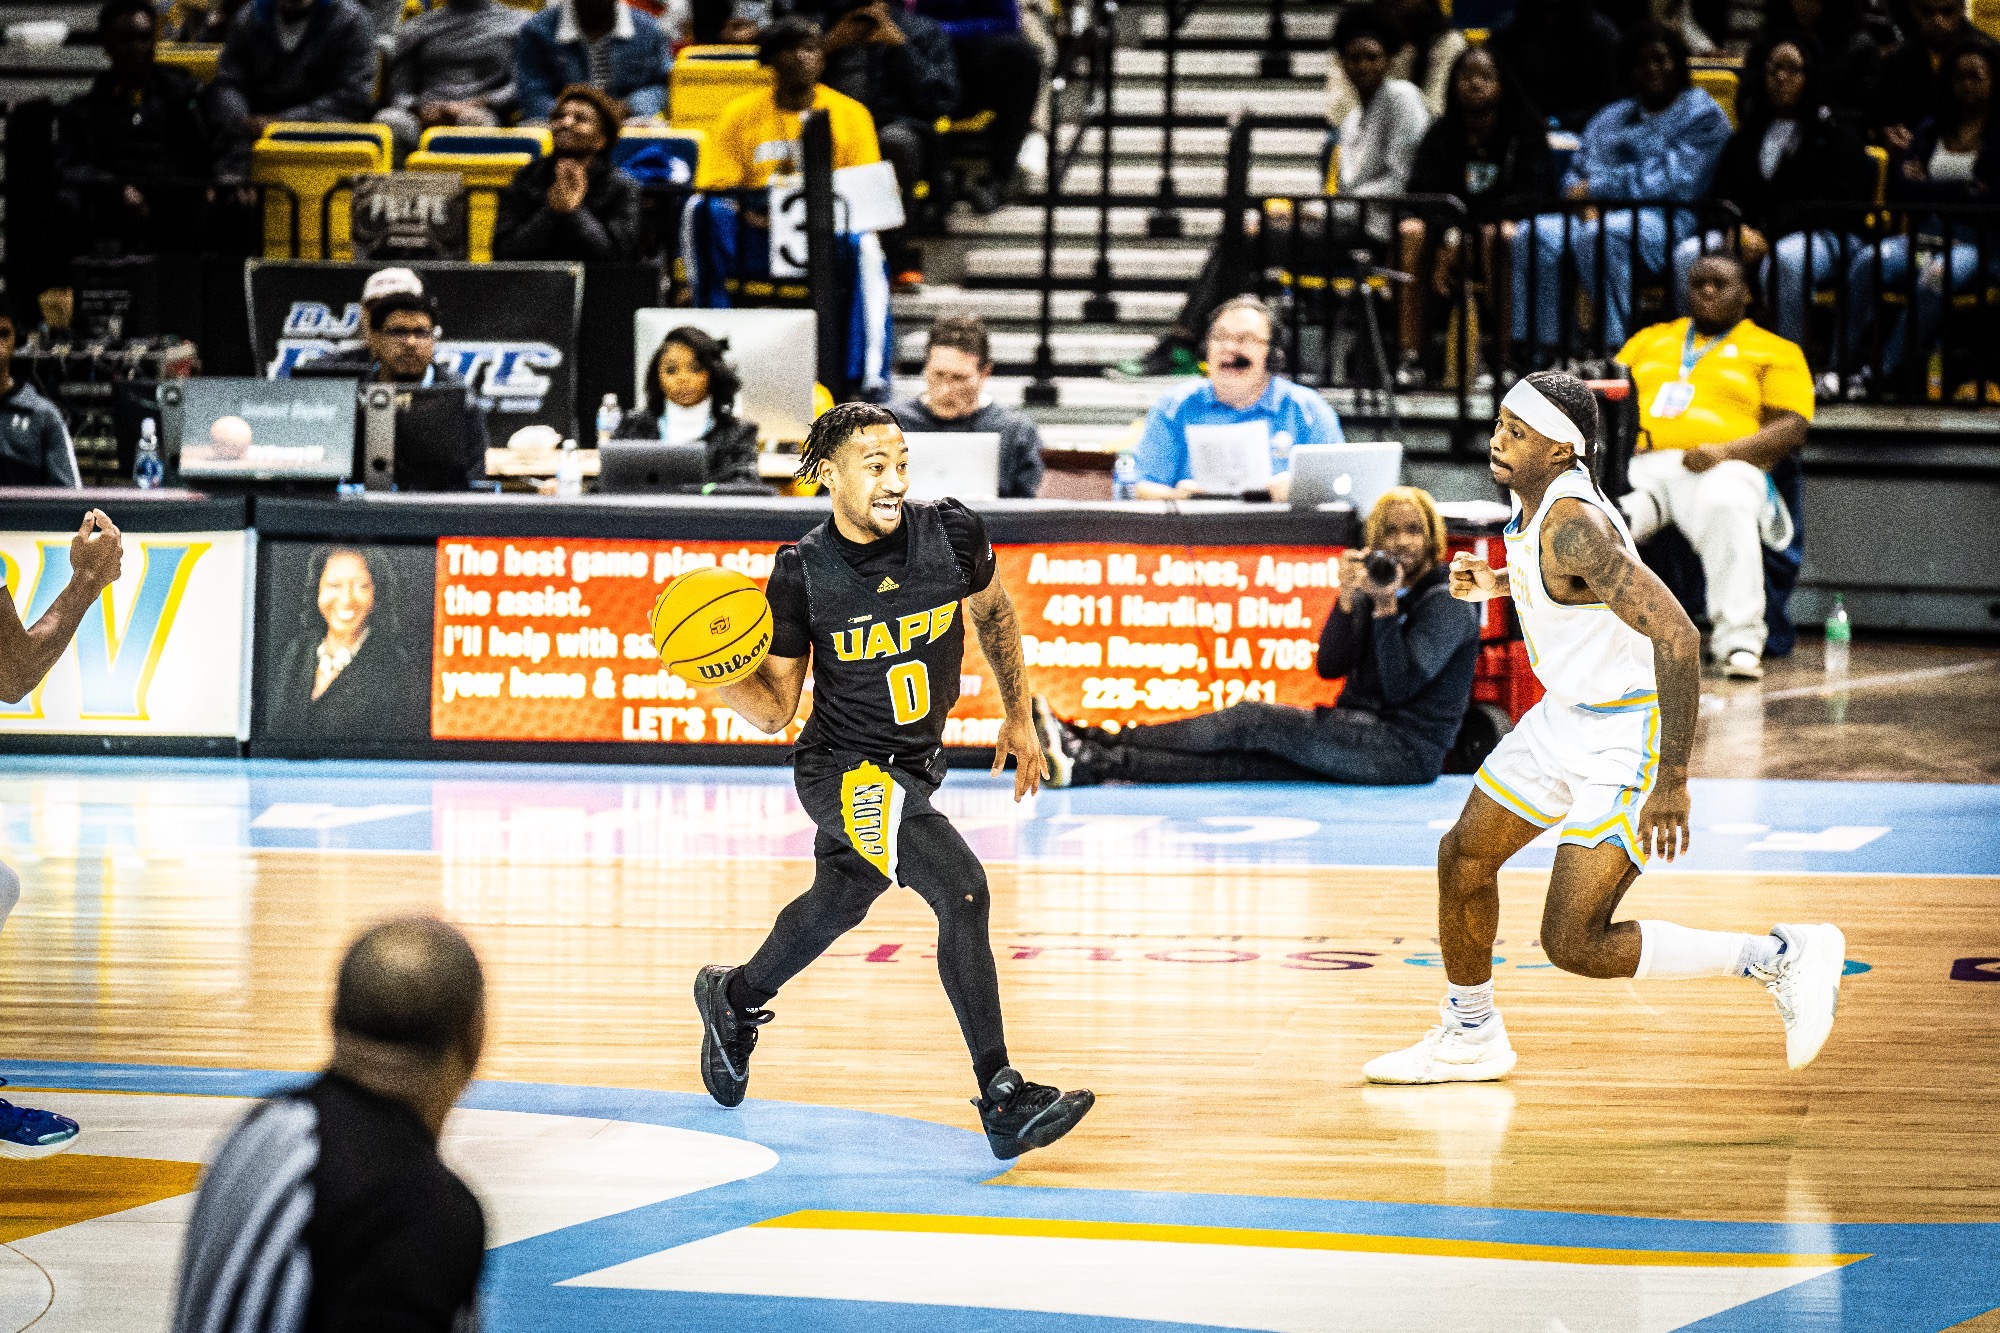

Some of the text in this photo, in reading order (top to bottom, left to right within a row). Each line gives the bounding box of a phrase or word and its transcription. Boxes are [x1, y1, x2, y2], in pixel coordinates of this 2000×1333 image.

[446, 544, 777, 584] The best game plan star
[1026, 553, 1341, 593] Anna M. Jones, Agent
[444, 585, 591, 617] the assist.
[1043, 595, 1312, 633] 4811 Harding Blvd.
[443, 625, 482, 657] I'll
[489, 626, 550, 663] help
[556, 627, 618, 658] with
[830, 600, 959, 662] UAPB
[696, 632, 769, 680] Wilson
[1107, 636, 1207, 674] Rouge,
[1215, 637, 1252, 669] LA
[441, 667, 697, 703] your home & auto.
[886, 659, 931, 726] 0
[622, 706, 788, 742] LET'S TA
[852, 783, 885, 856] GOLDEN
